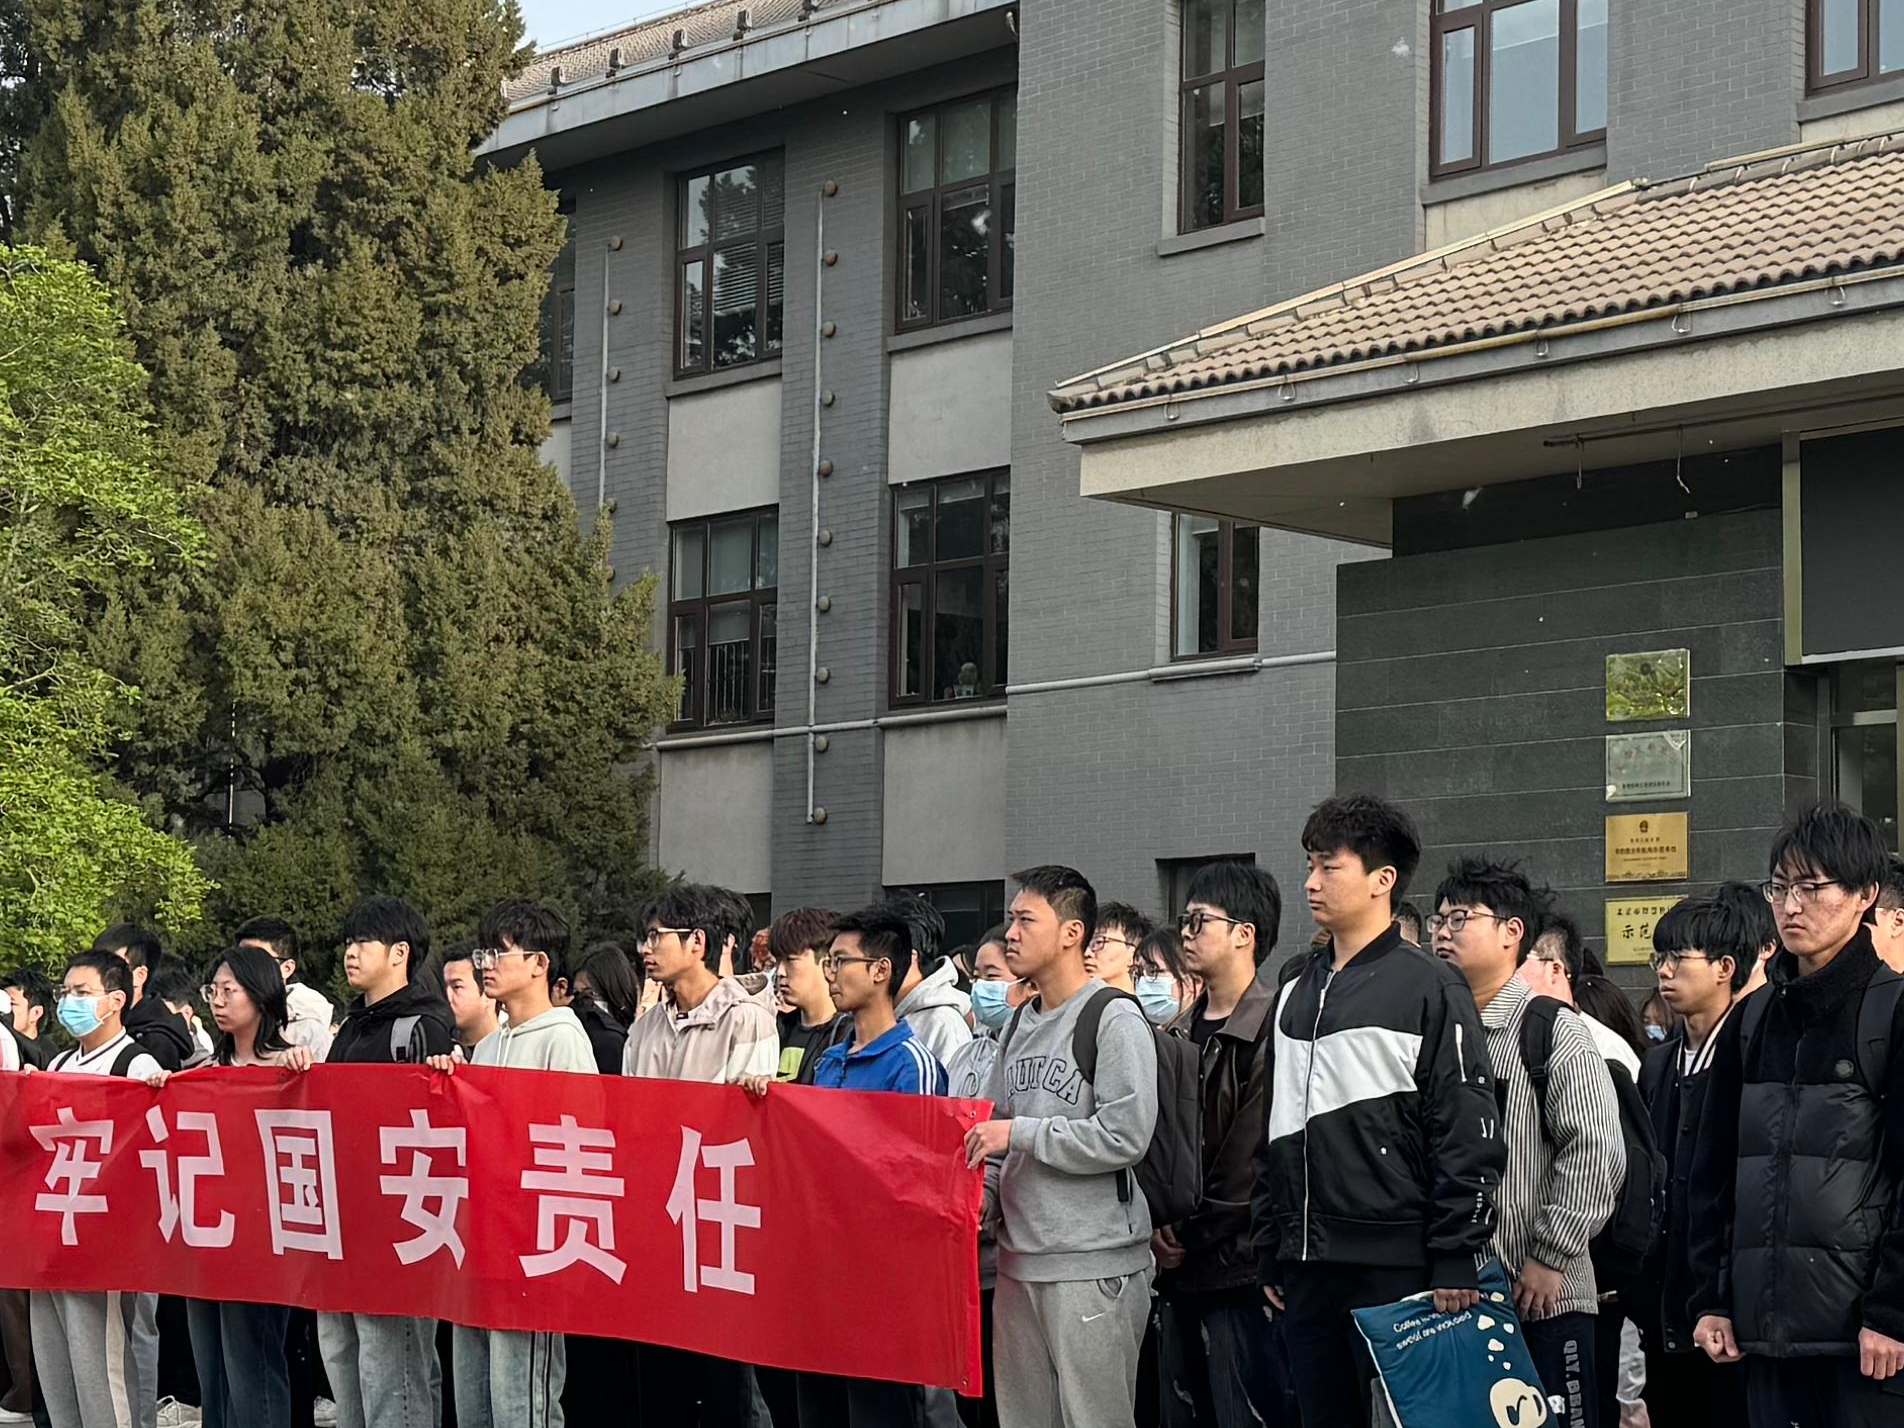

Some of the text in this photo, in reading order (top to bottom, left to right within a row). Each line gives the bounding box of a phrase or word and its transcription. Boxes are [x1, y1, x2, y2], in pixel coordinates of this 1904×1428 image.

[29, 1105, 761, 1295] 牢记国安责任
